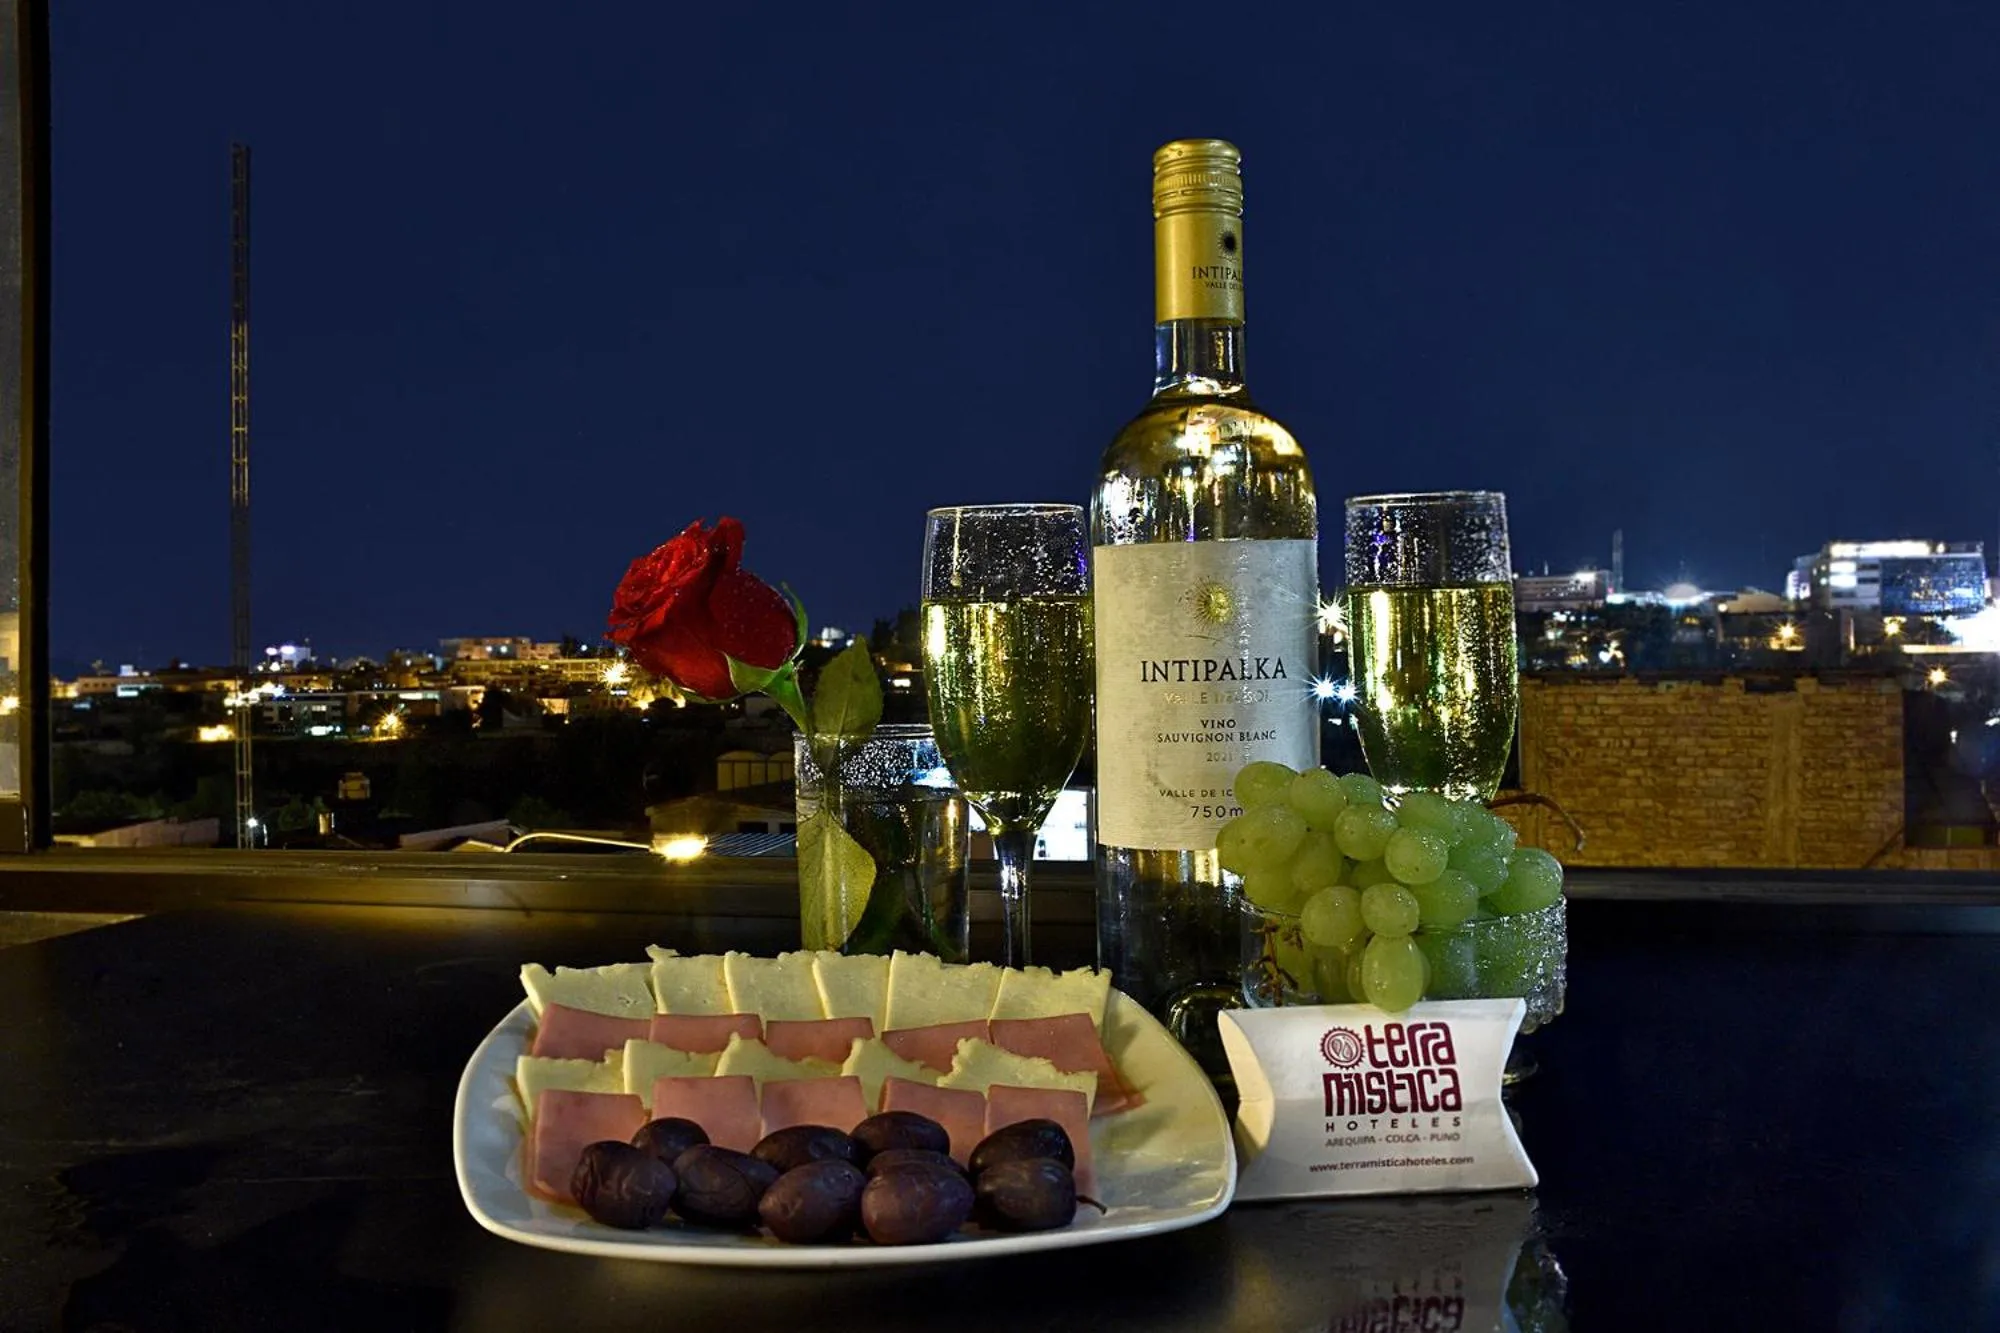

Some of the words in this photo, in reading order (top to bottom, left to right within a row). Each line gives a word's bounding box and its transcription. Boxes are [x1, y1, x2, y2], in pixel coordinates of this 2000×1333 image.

[1141, 657, 1288, 682] INTIPALKA
[1200, 719, 1237, 729] VINO
[1157, 733, 1235, 743] SAUVIGNON
[1239, 730, 1278, 742] BLANC
[1159, 789, 1195, 798] VALLE
[1200, 789, 1217, 798] DE
[1221, 788, 1234, 798] IC
[1191, 806, 1244, 819] 750m
[1364, 1022, 1456, 1069] terra
[1325, 1117, 1461, 1132] HOTELES
[1325, 1135, 1376, 1147] AREQUIPA
[1385, 1133, 1421, 1144] COLCA
[1430, 1132, 1460, 1142] PUNO
[1309, 1156, 1474, 1173] www.terramisticahoteles.com
